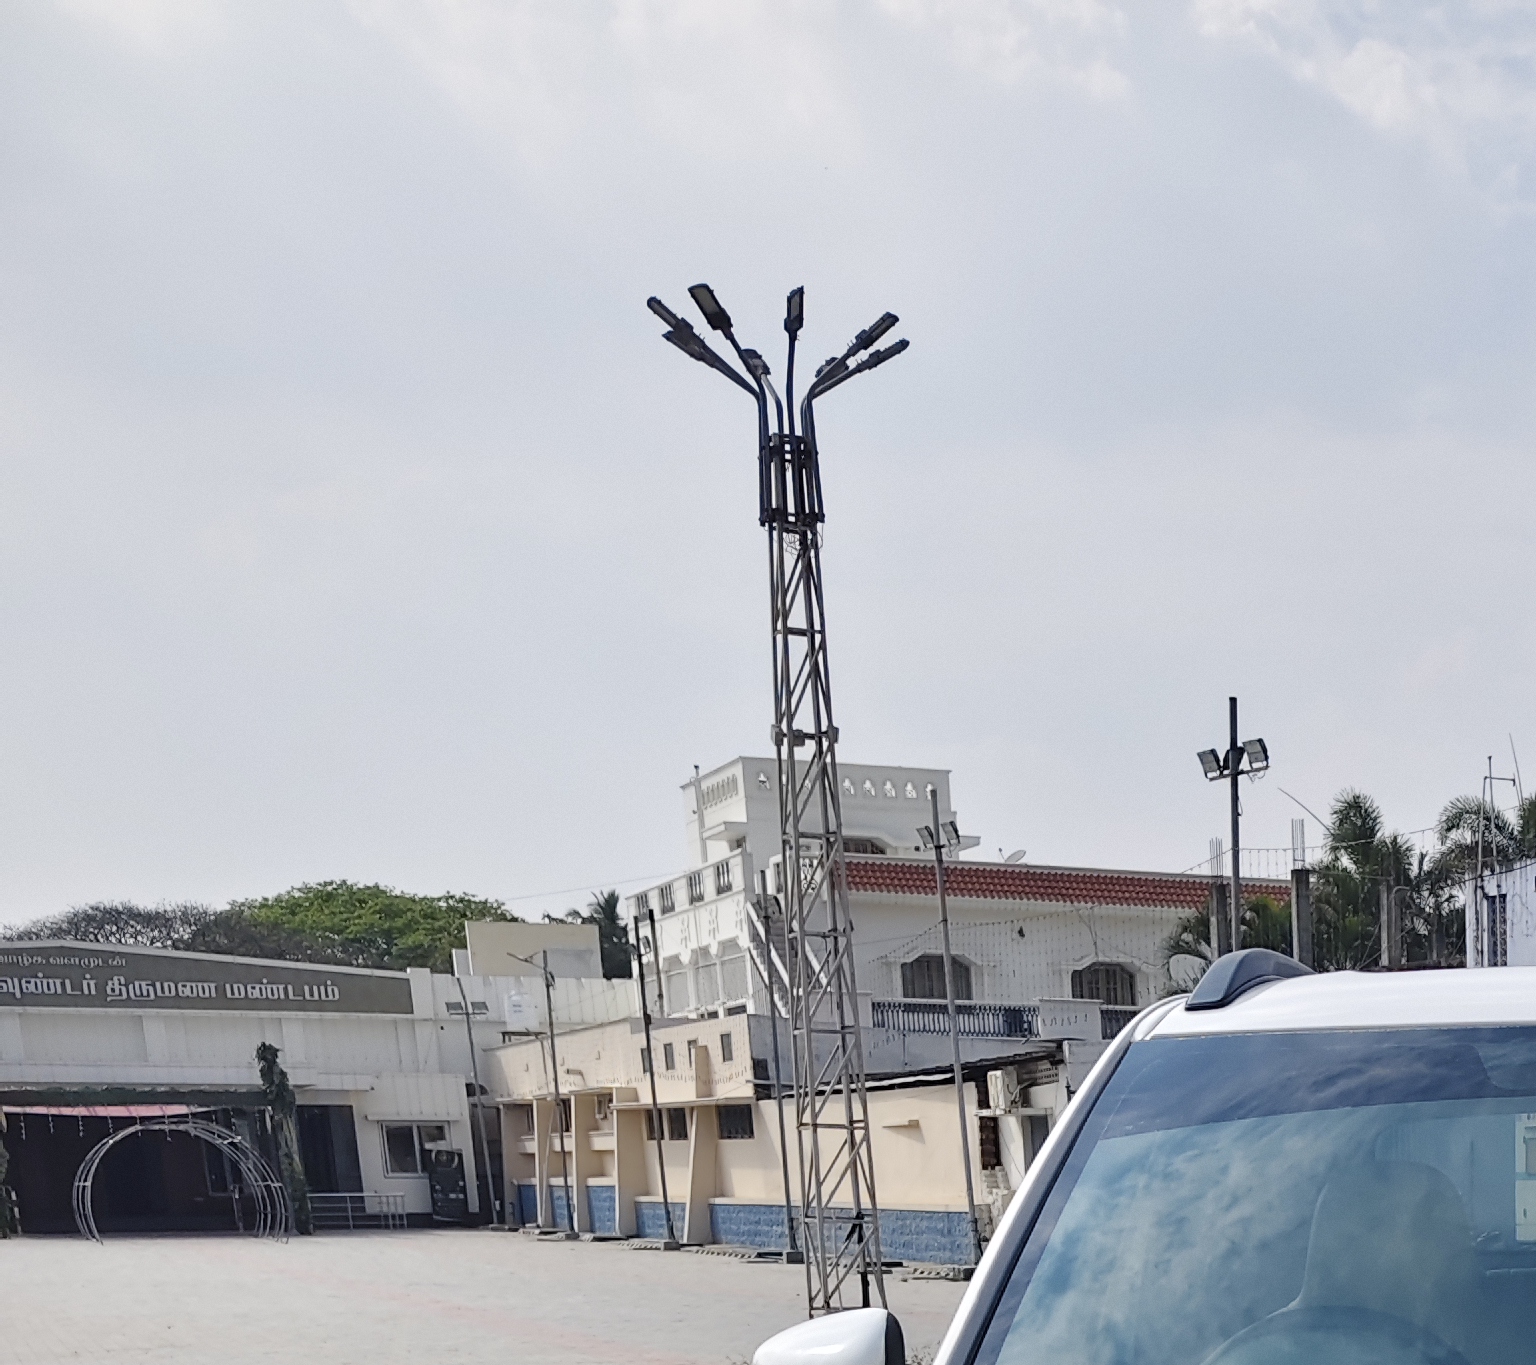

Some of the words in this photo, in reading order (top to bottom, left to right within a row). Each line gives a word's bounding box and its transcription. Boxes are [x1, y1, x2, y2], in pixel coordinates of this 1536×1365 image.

[49, 955, 126, 969] வளமுடன்
[106, 975, 217, 1003] திருமண
[226, 978, 341, 1002] மண்டபம்
